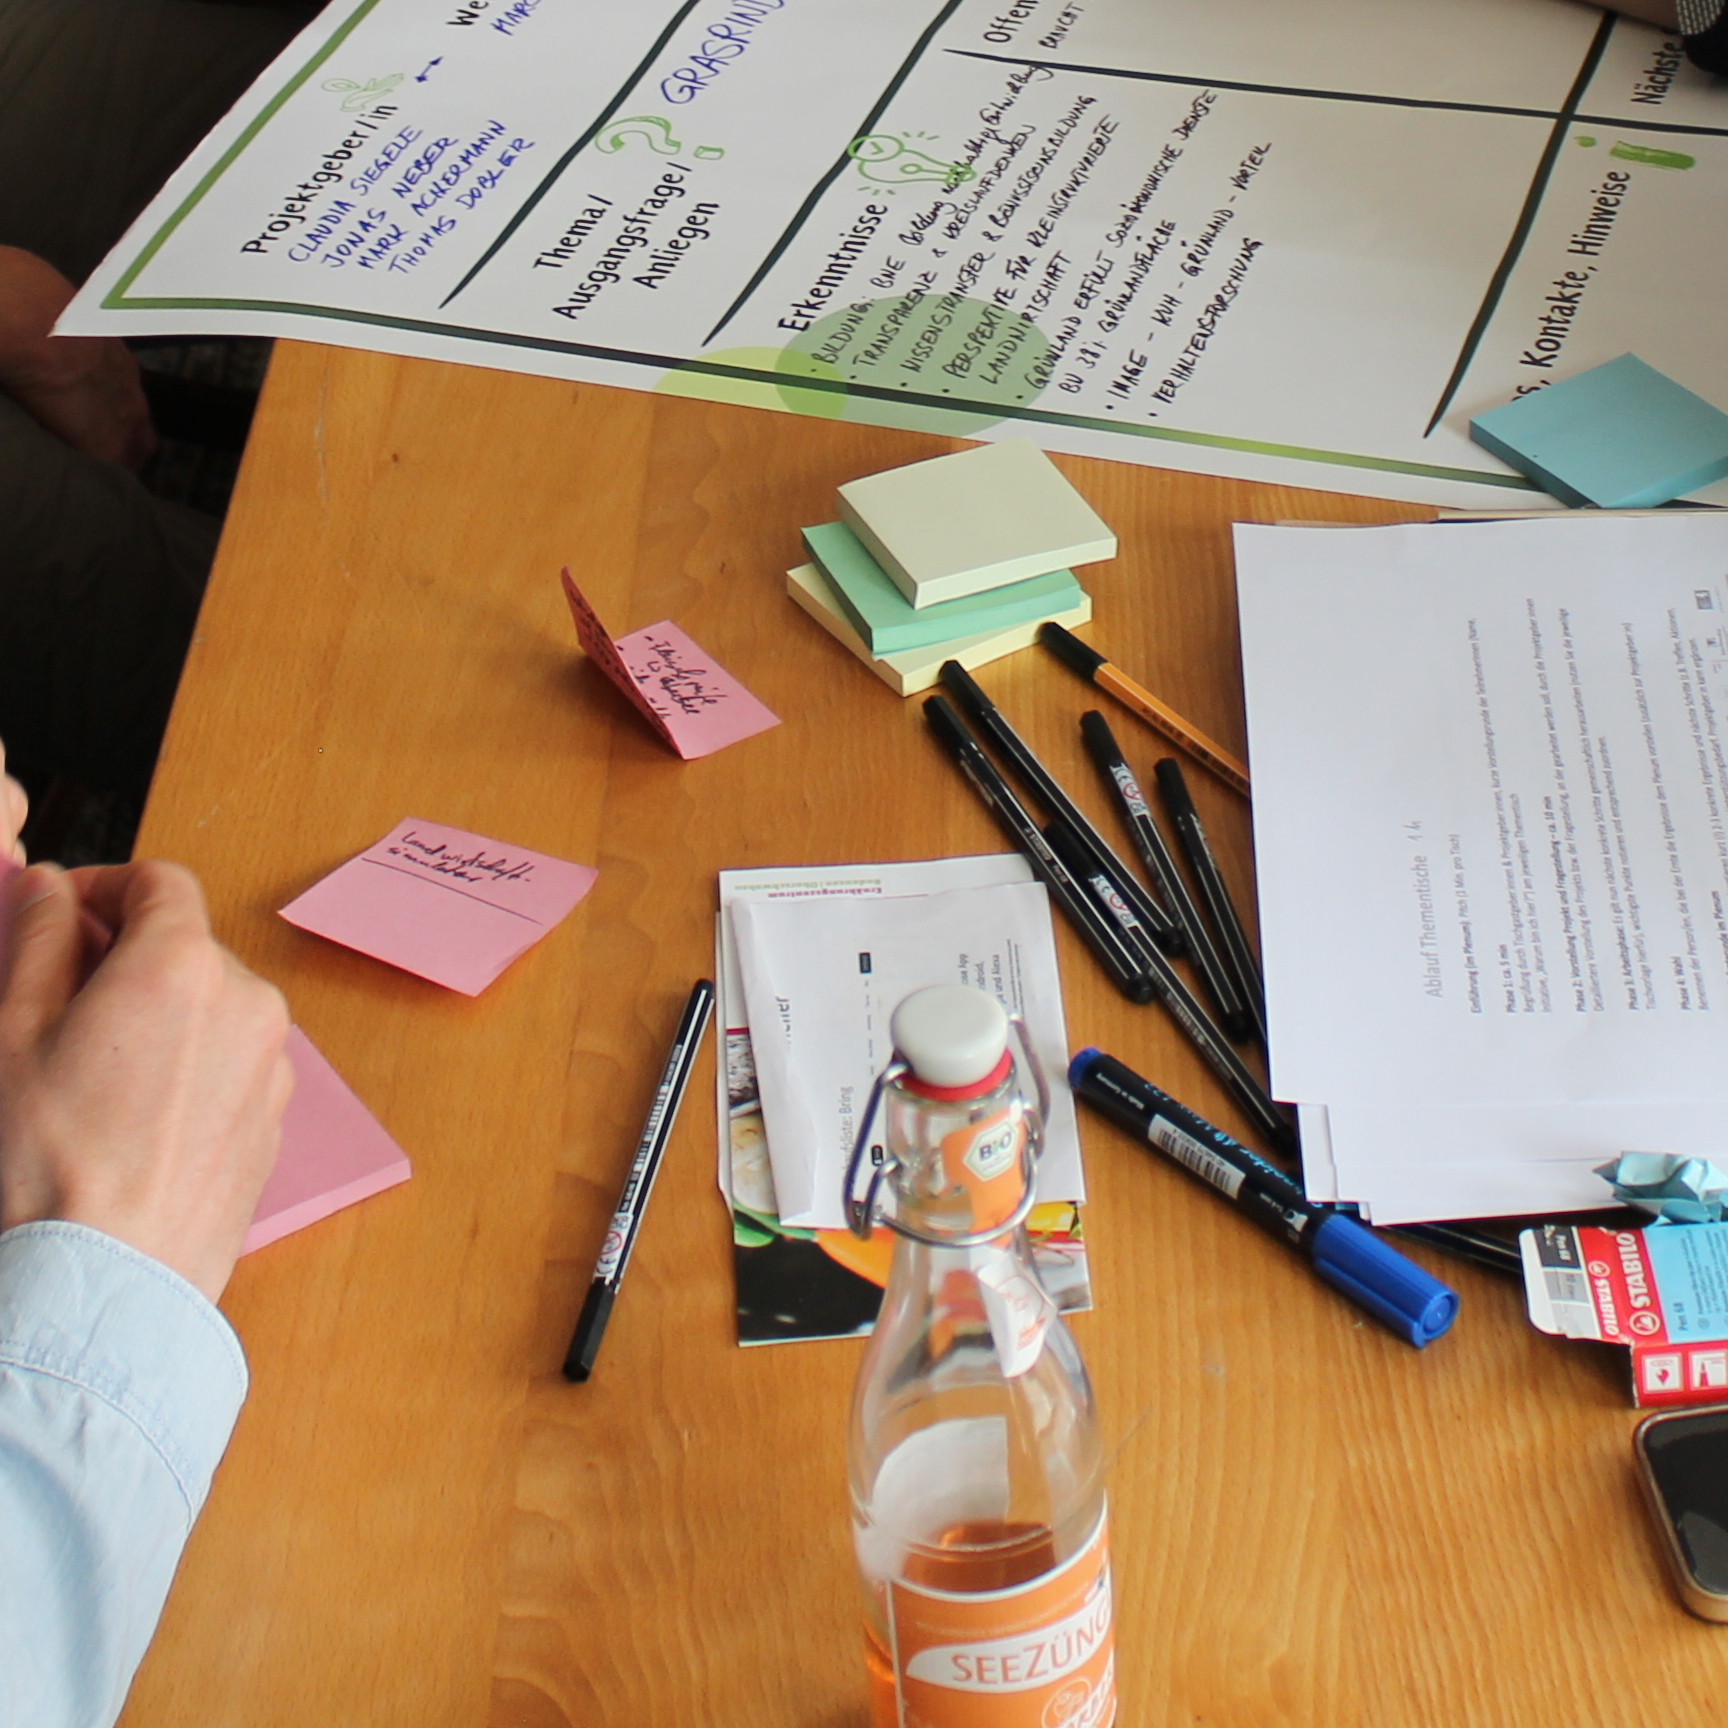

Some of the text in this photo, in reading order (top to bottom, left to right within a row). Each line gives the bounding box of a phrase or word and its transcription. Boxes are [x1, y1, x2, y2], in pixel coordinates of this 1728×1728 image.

[288, 125, 423, 263] CLAUDIA SIEGELE
[320, 207, 387, 268] JONAS
[356, 223, 410, 270] MARK
[388, 214, 457, 274] THOMAS
[632, 202, 720, 289] Anliegen
[777, 203, 888, 333] Erkenntnisse
[870, 255, 906, 289] BNE
[1519, 265, 1598, 369] Kontakte,
[1567, 170, 1632, 256] Hinweise
[852, 270, 938, 367] TRANSPARENZ
[942, 286, 1018, 379] PERSPEKTIVE
[1106, 349, 1149, 400] IMAGE
[1151, 293, 1183, 327] KUH
[1543, 795, 1552, 810] min
[1550, 840, 1566, 888] Fragestellung
[1412, 856, 1441, 996] Ablauf Thementische
[1556, 890, 1568, 904] und
[1560, 906, 1573, 933] Projekt
[1498, 944, 1508, 959] min
[1566, 935, 1580, 978] Vorstellung
[1505, 989, 1516, 1012] Phase
[1575, 989, 1585, 1012] Phase
[838, 1085, 855, 1115] Bring
[1616, 1232, 1651, 1308] STABILO
[1594, 1278, 1620, 1336] STABILO
